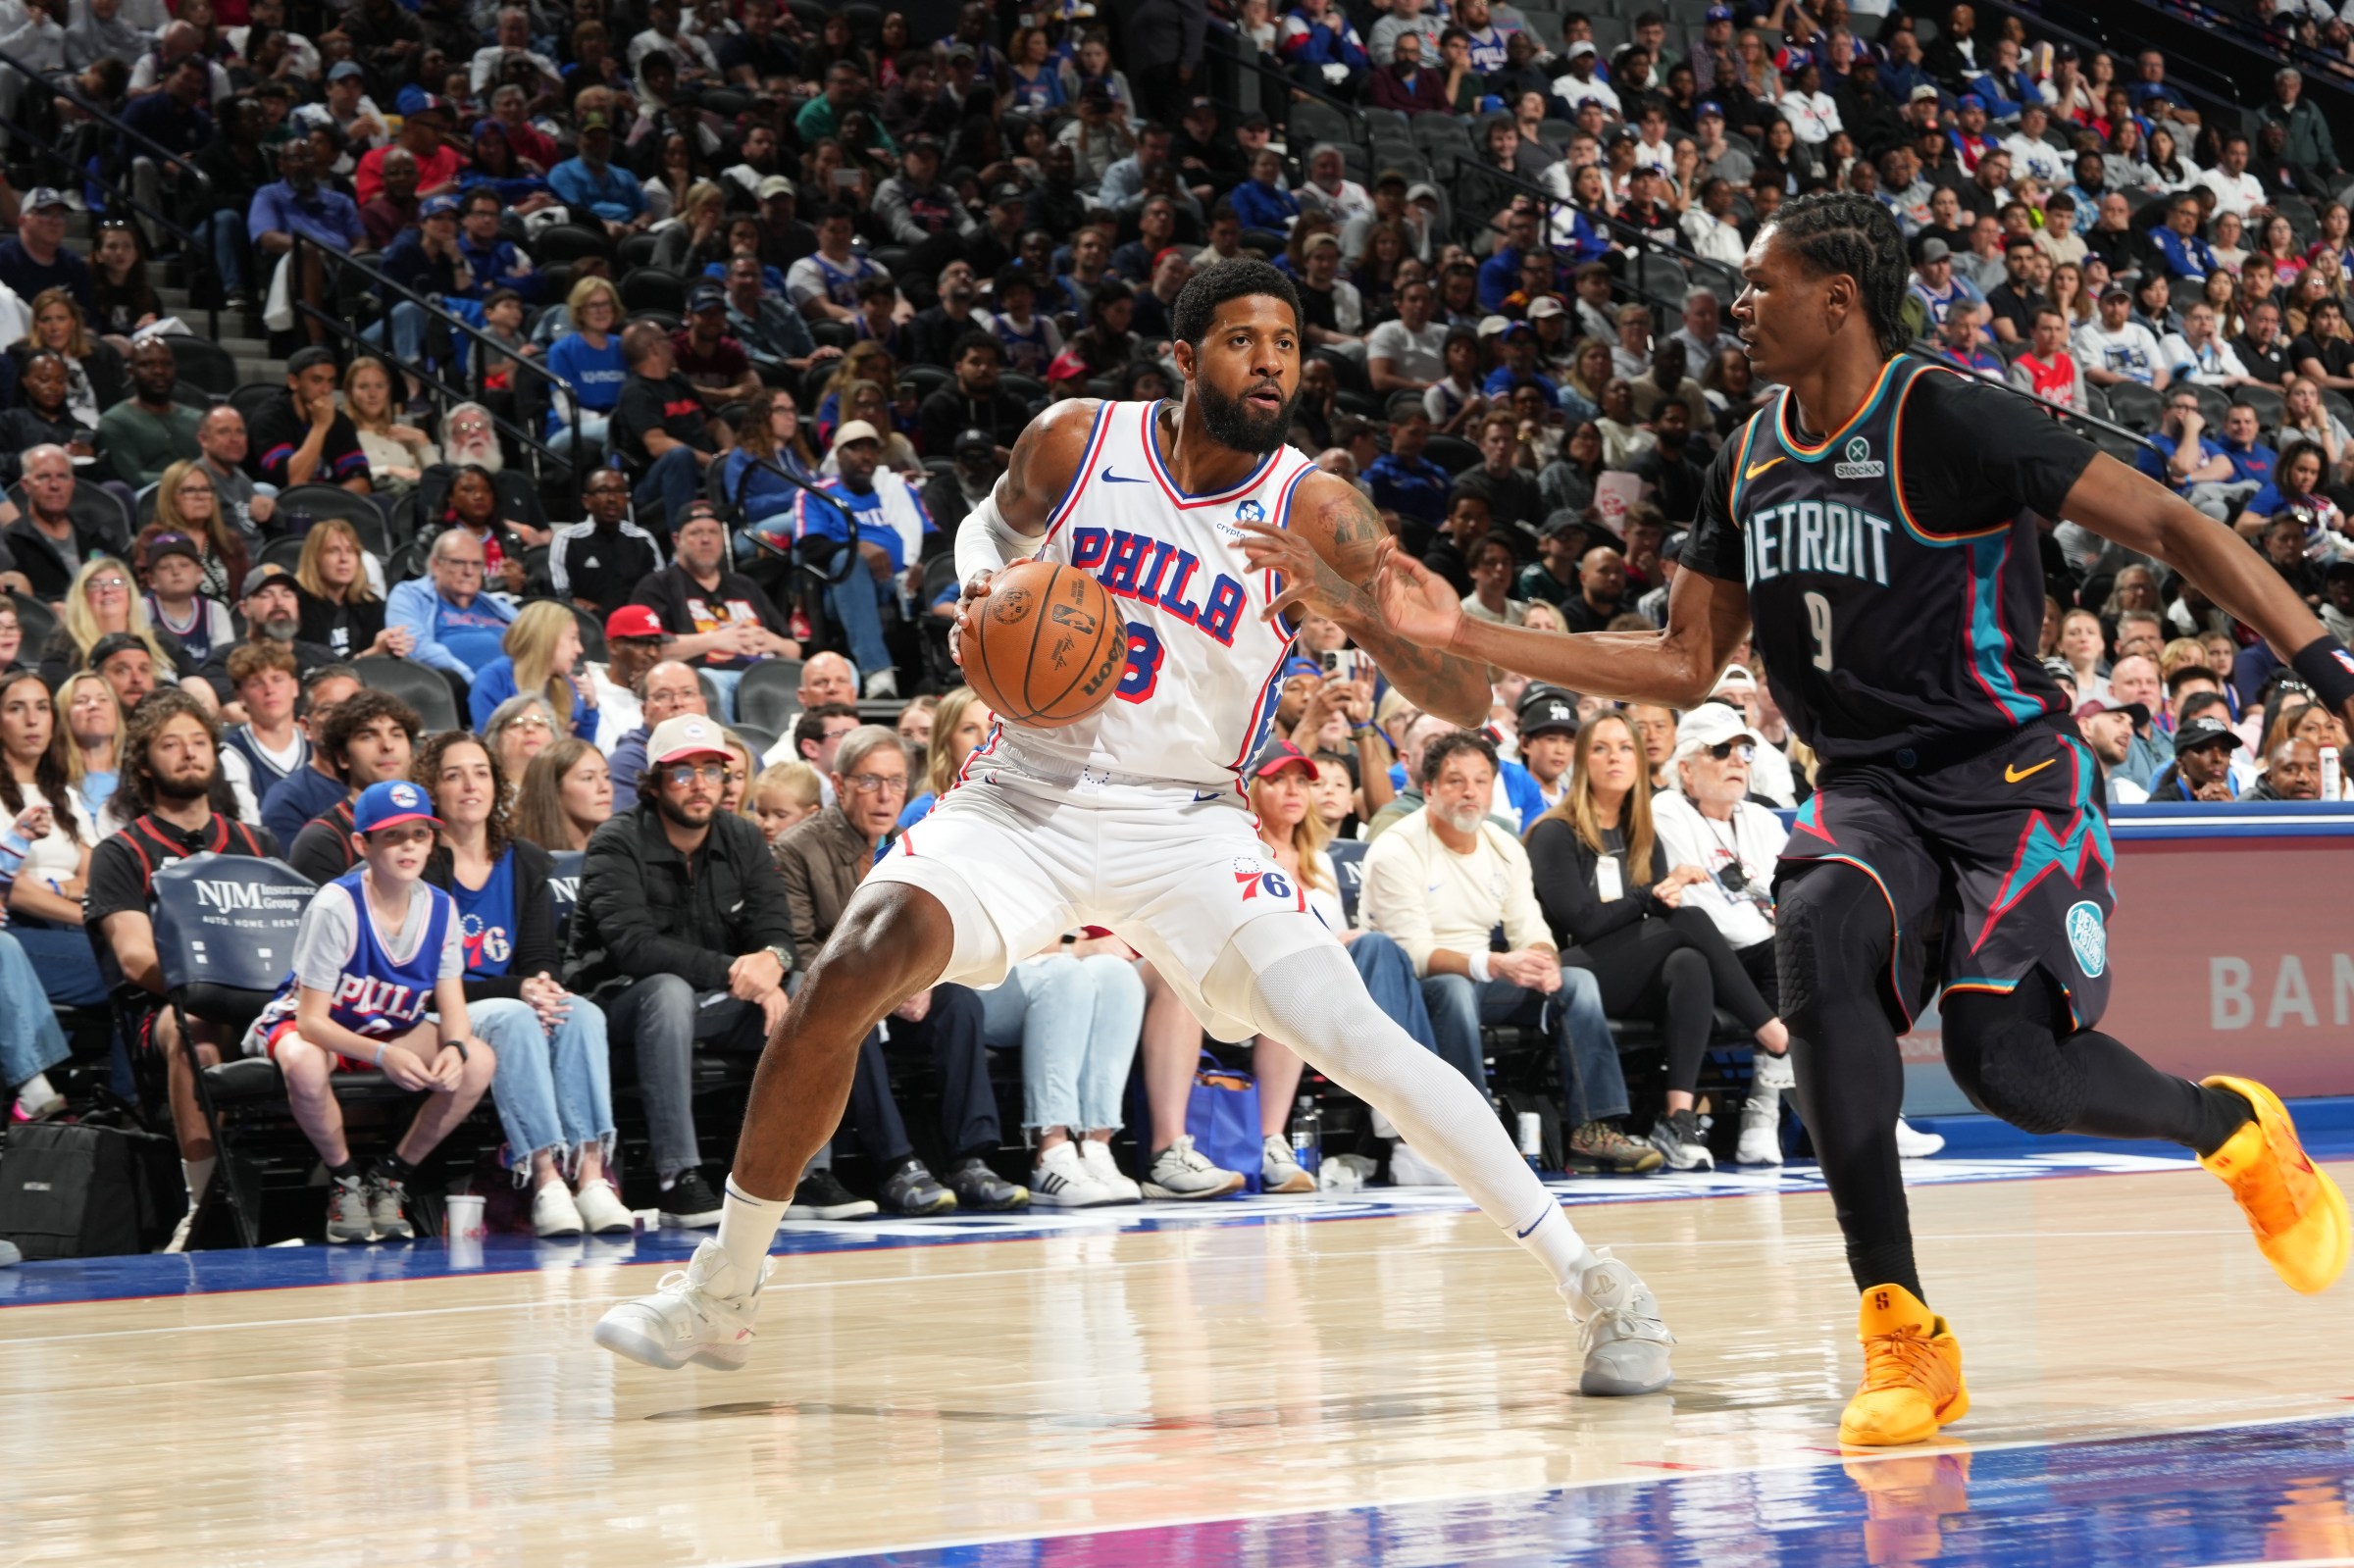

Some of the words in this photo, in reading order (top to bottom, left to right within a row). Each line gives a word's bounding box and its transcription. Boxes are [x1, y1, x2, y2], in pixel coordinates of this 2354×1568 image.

[1837, 464, 1882, 477] StockX
[1744, 500, 1893, 594] DETROIT
[1071, 527, 1248, 649] PHILA
[1804, 590, 1833, 674] 9
[193, 880, 264, 914] NJM
[261, 884, 317, 896] Insurance
[263, 897, 300, 912] Group
[1234, 871, 1292, 902] 76
[462, 926, 512, 969] 76
